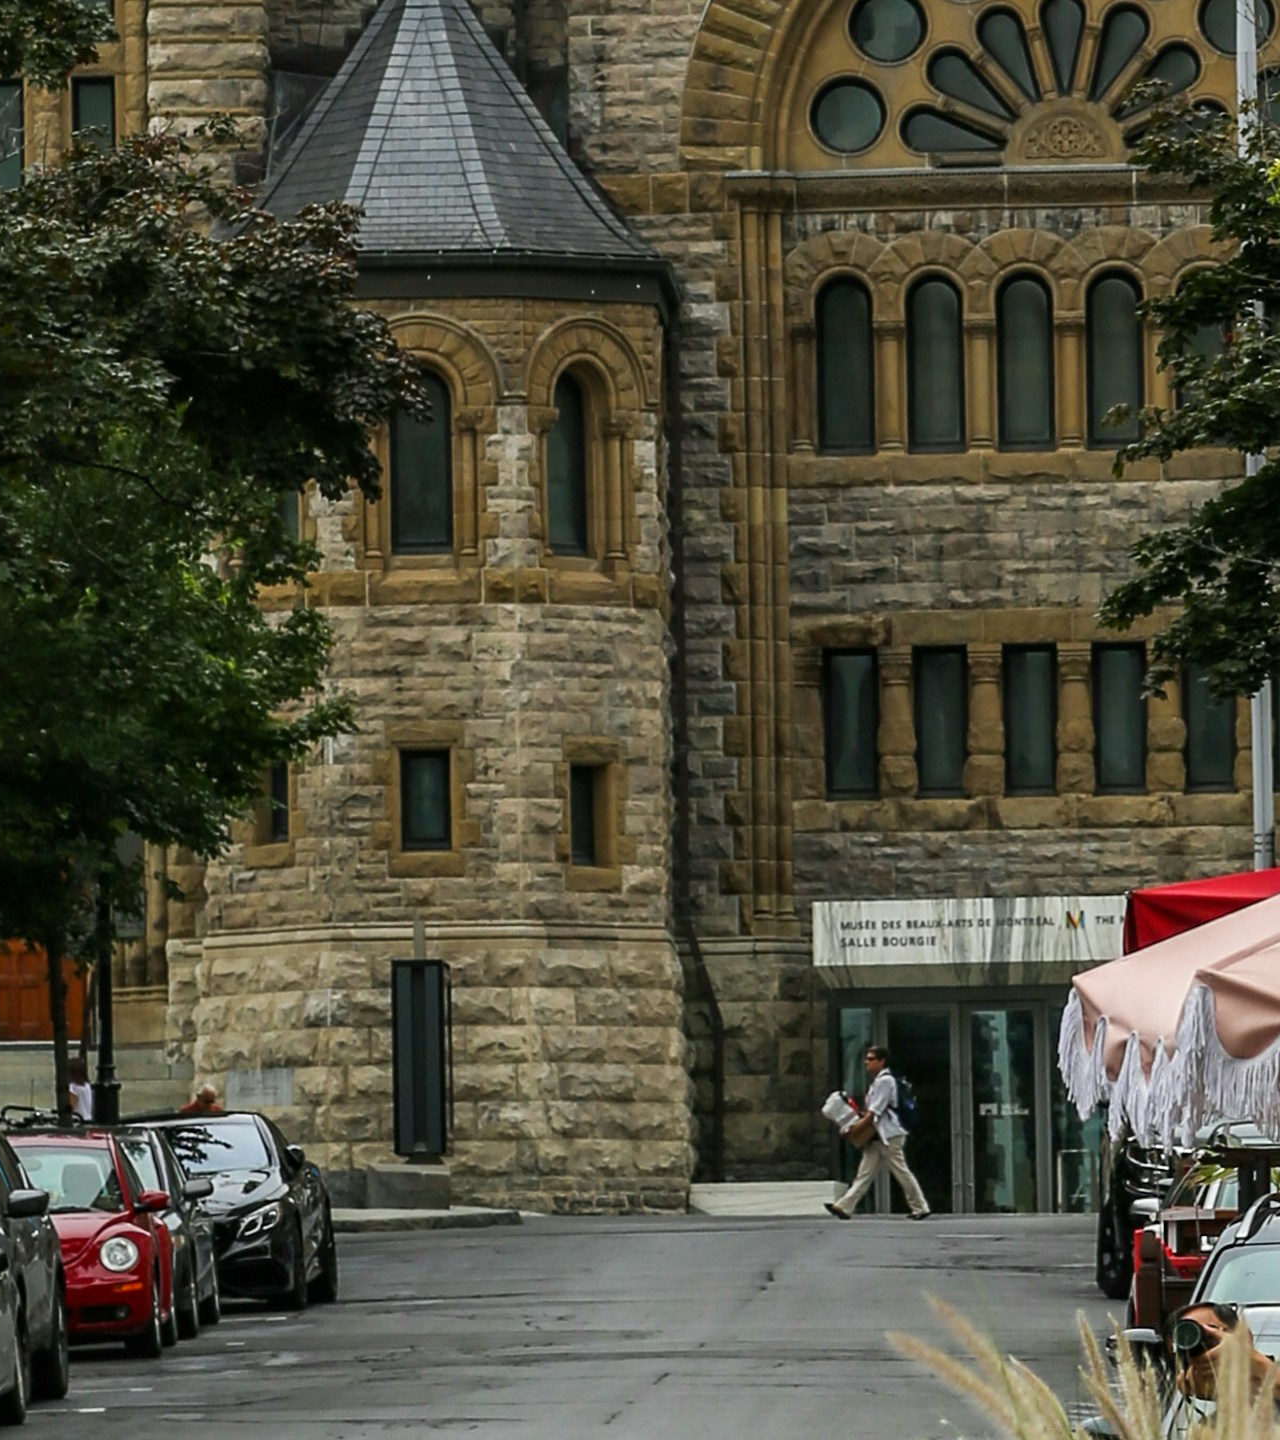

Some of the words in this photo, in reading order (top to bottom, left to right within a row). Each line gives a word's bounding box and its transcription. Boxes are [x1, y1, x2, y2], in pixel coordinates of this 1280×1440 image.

[881, 919, 902, 930] DES
[906, 918, 974, 929] BEAUX-ARTS
[978, 919, 991, 927] DE
[1095, 915, 1115, 925] THE
[840, 936, 877, 948] SALLE
[882, 935, 937, 947] BOURGIE
